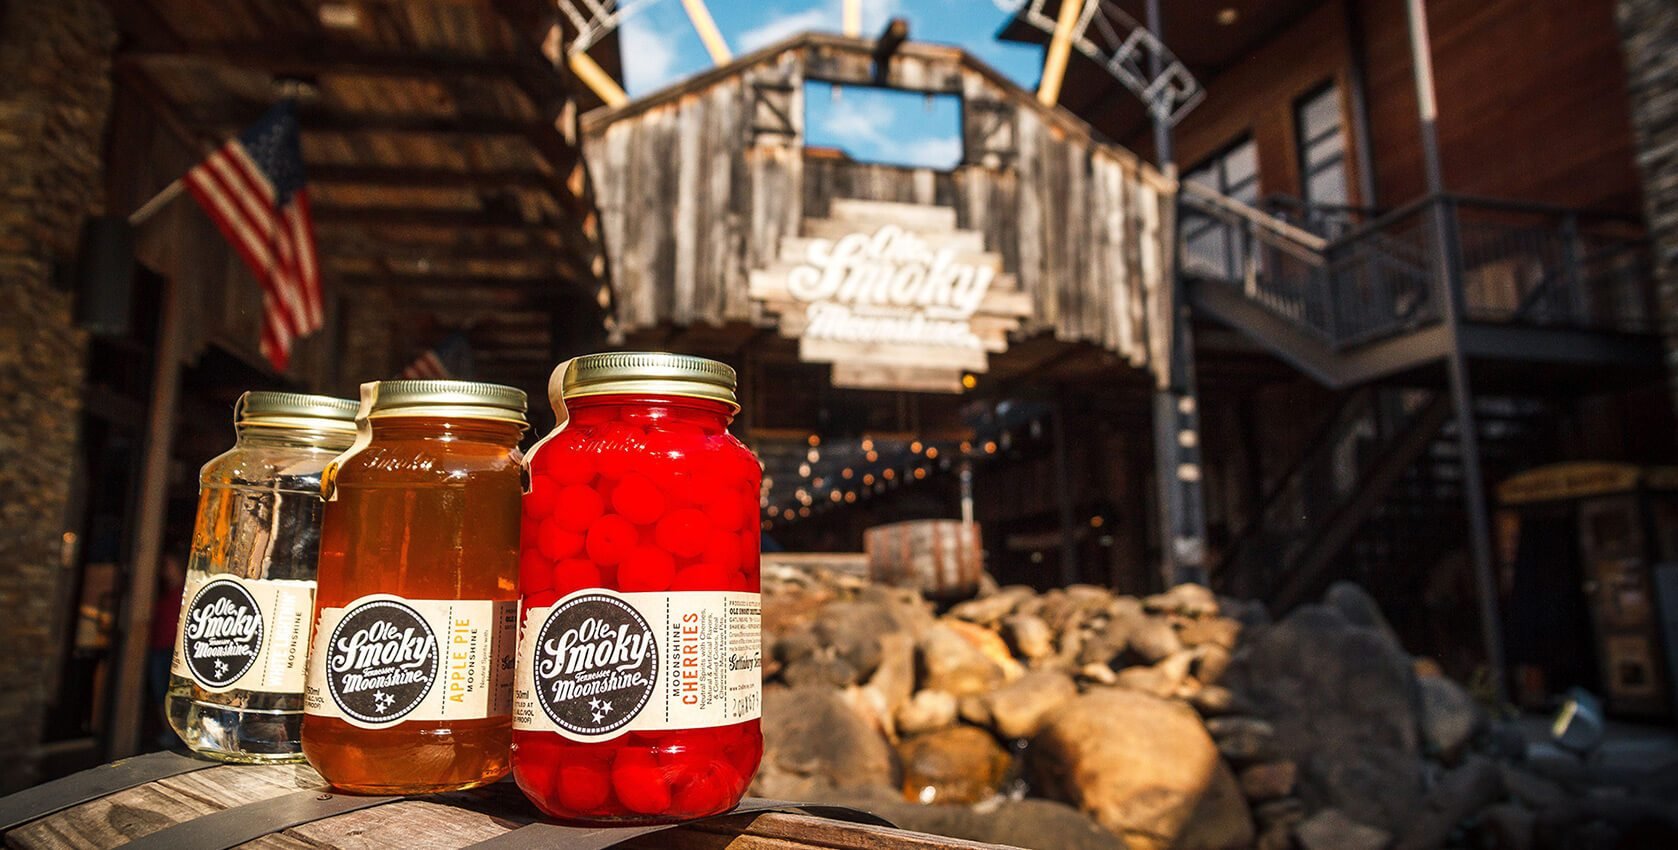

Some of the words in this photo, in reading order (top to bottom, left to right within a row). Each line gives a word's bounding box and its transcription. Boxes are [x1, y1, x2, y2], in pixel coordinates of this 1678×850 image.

[787, 232, 995, 320] Smoky
[187, 603, 262, 642] Smoky
[215, 596, 238, 616] Ole
[193, 641, 253, 659] Moonshine
[287, 612, 302, 669] MOONSHINE
[331, 627, 435, 673] Smoky
[369, 620, 403, 642] Ole
[453, 619, 470, 644] PIE
[579, 617, 617, 642] Ole
[466, 628, 478, 693] MOONSHINE
[540, 624, 653, 679] Smoky
[672, 623, 681, 697] MOONSHINE
[682, 612, 699, 706] CHERRIES
[341, 669, 429, 694] Moonshine
[449, 652, 468, 703] APPLE
[551, 671, 649, 703] Moonshine
